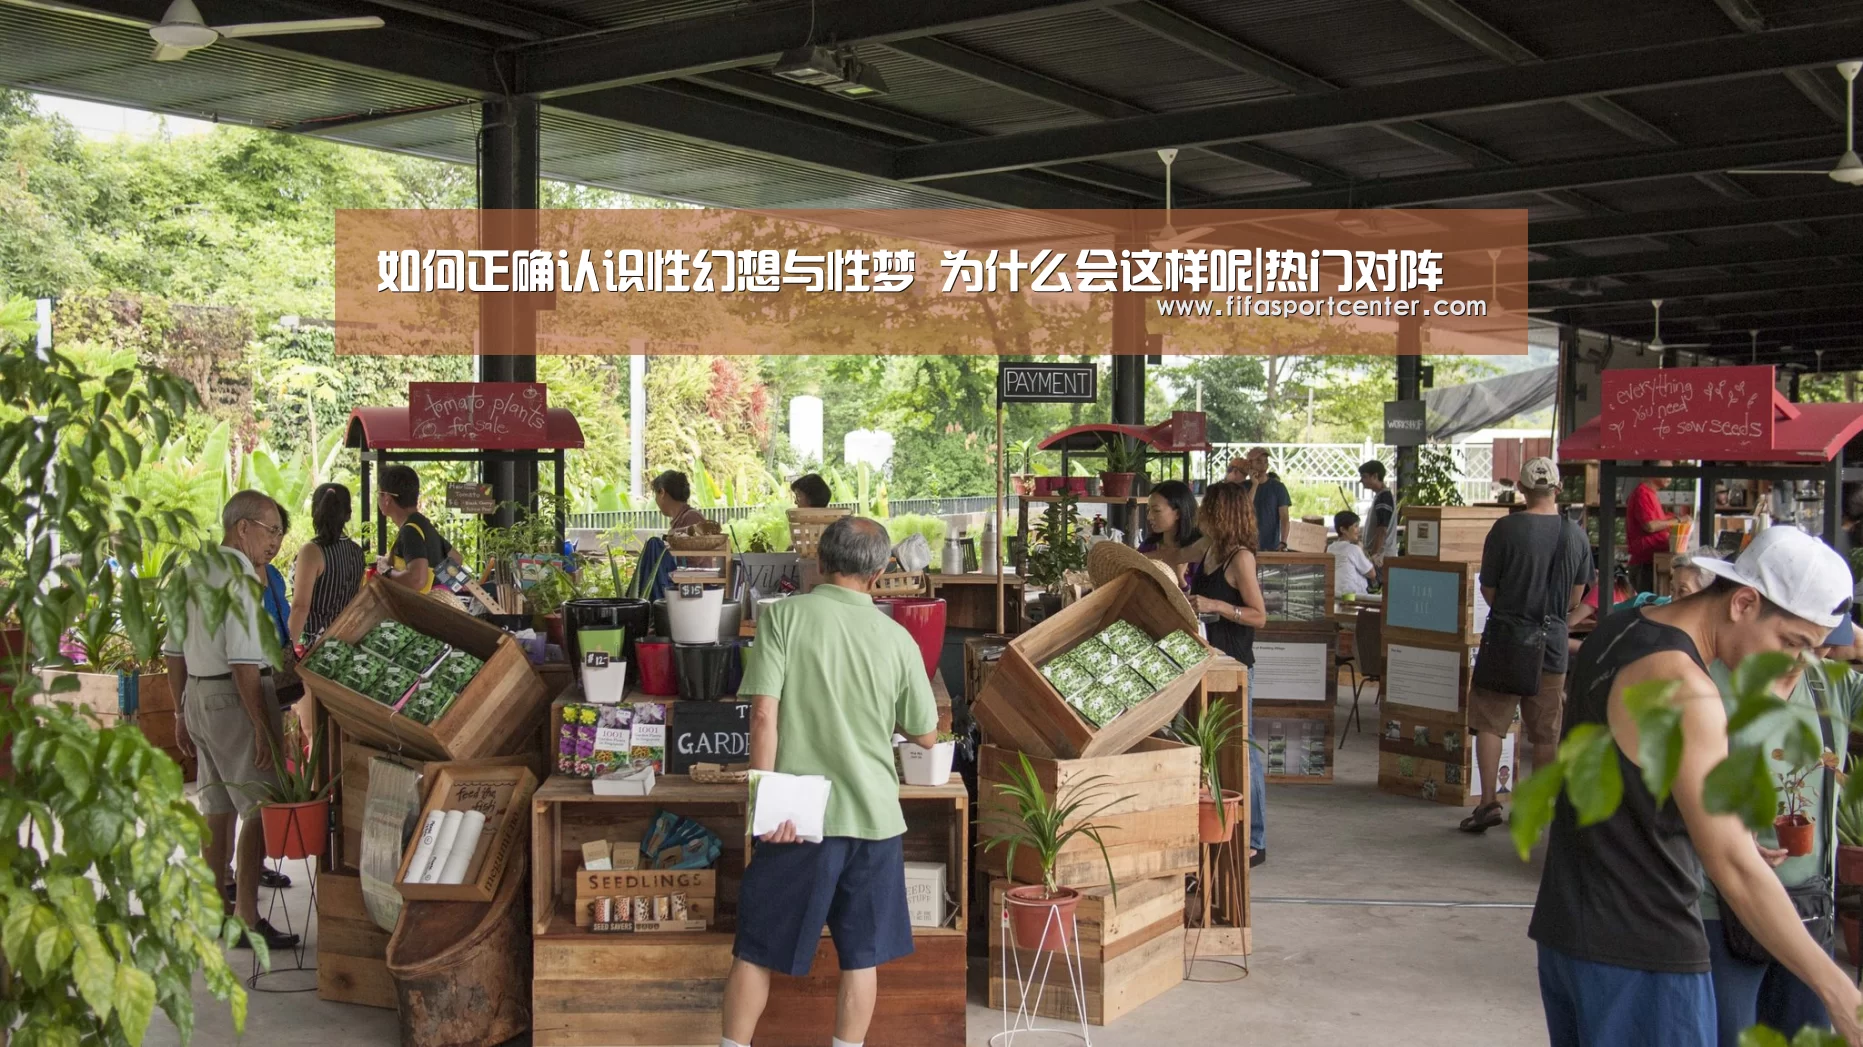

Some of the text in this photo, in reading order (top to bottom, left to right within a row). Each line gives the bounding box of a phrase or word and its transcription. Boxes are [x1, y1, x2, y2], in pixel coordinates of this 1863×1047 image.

[1006, 371, 1089, 394] PAYMENT
[1616, 373, 1693, 404] everything
[424, 385, 545, 429] tomato plants
[1657, 395, 1689, 419] need
[448, 416, 509, 436] for sale
[1387, 419, 1424, 430] WORKSHOP
[1653, 412, 1763, 439] to sow seeds
[681, 586, 701, 597] $15
[735, 704, 752, 719] T
[456, 786, 481, 802] feed
[588, 873, 702, 889] SEEDLINGS
[593, 923, 609, 931] SEED
[610, 923, 633, 931] SAVERS
